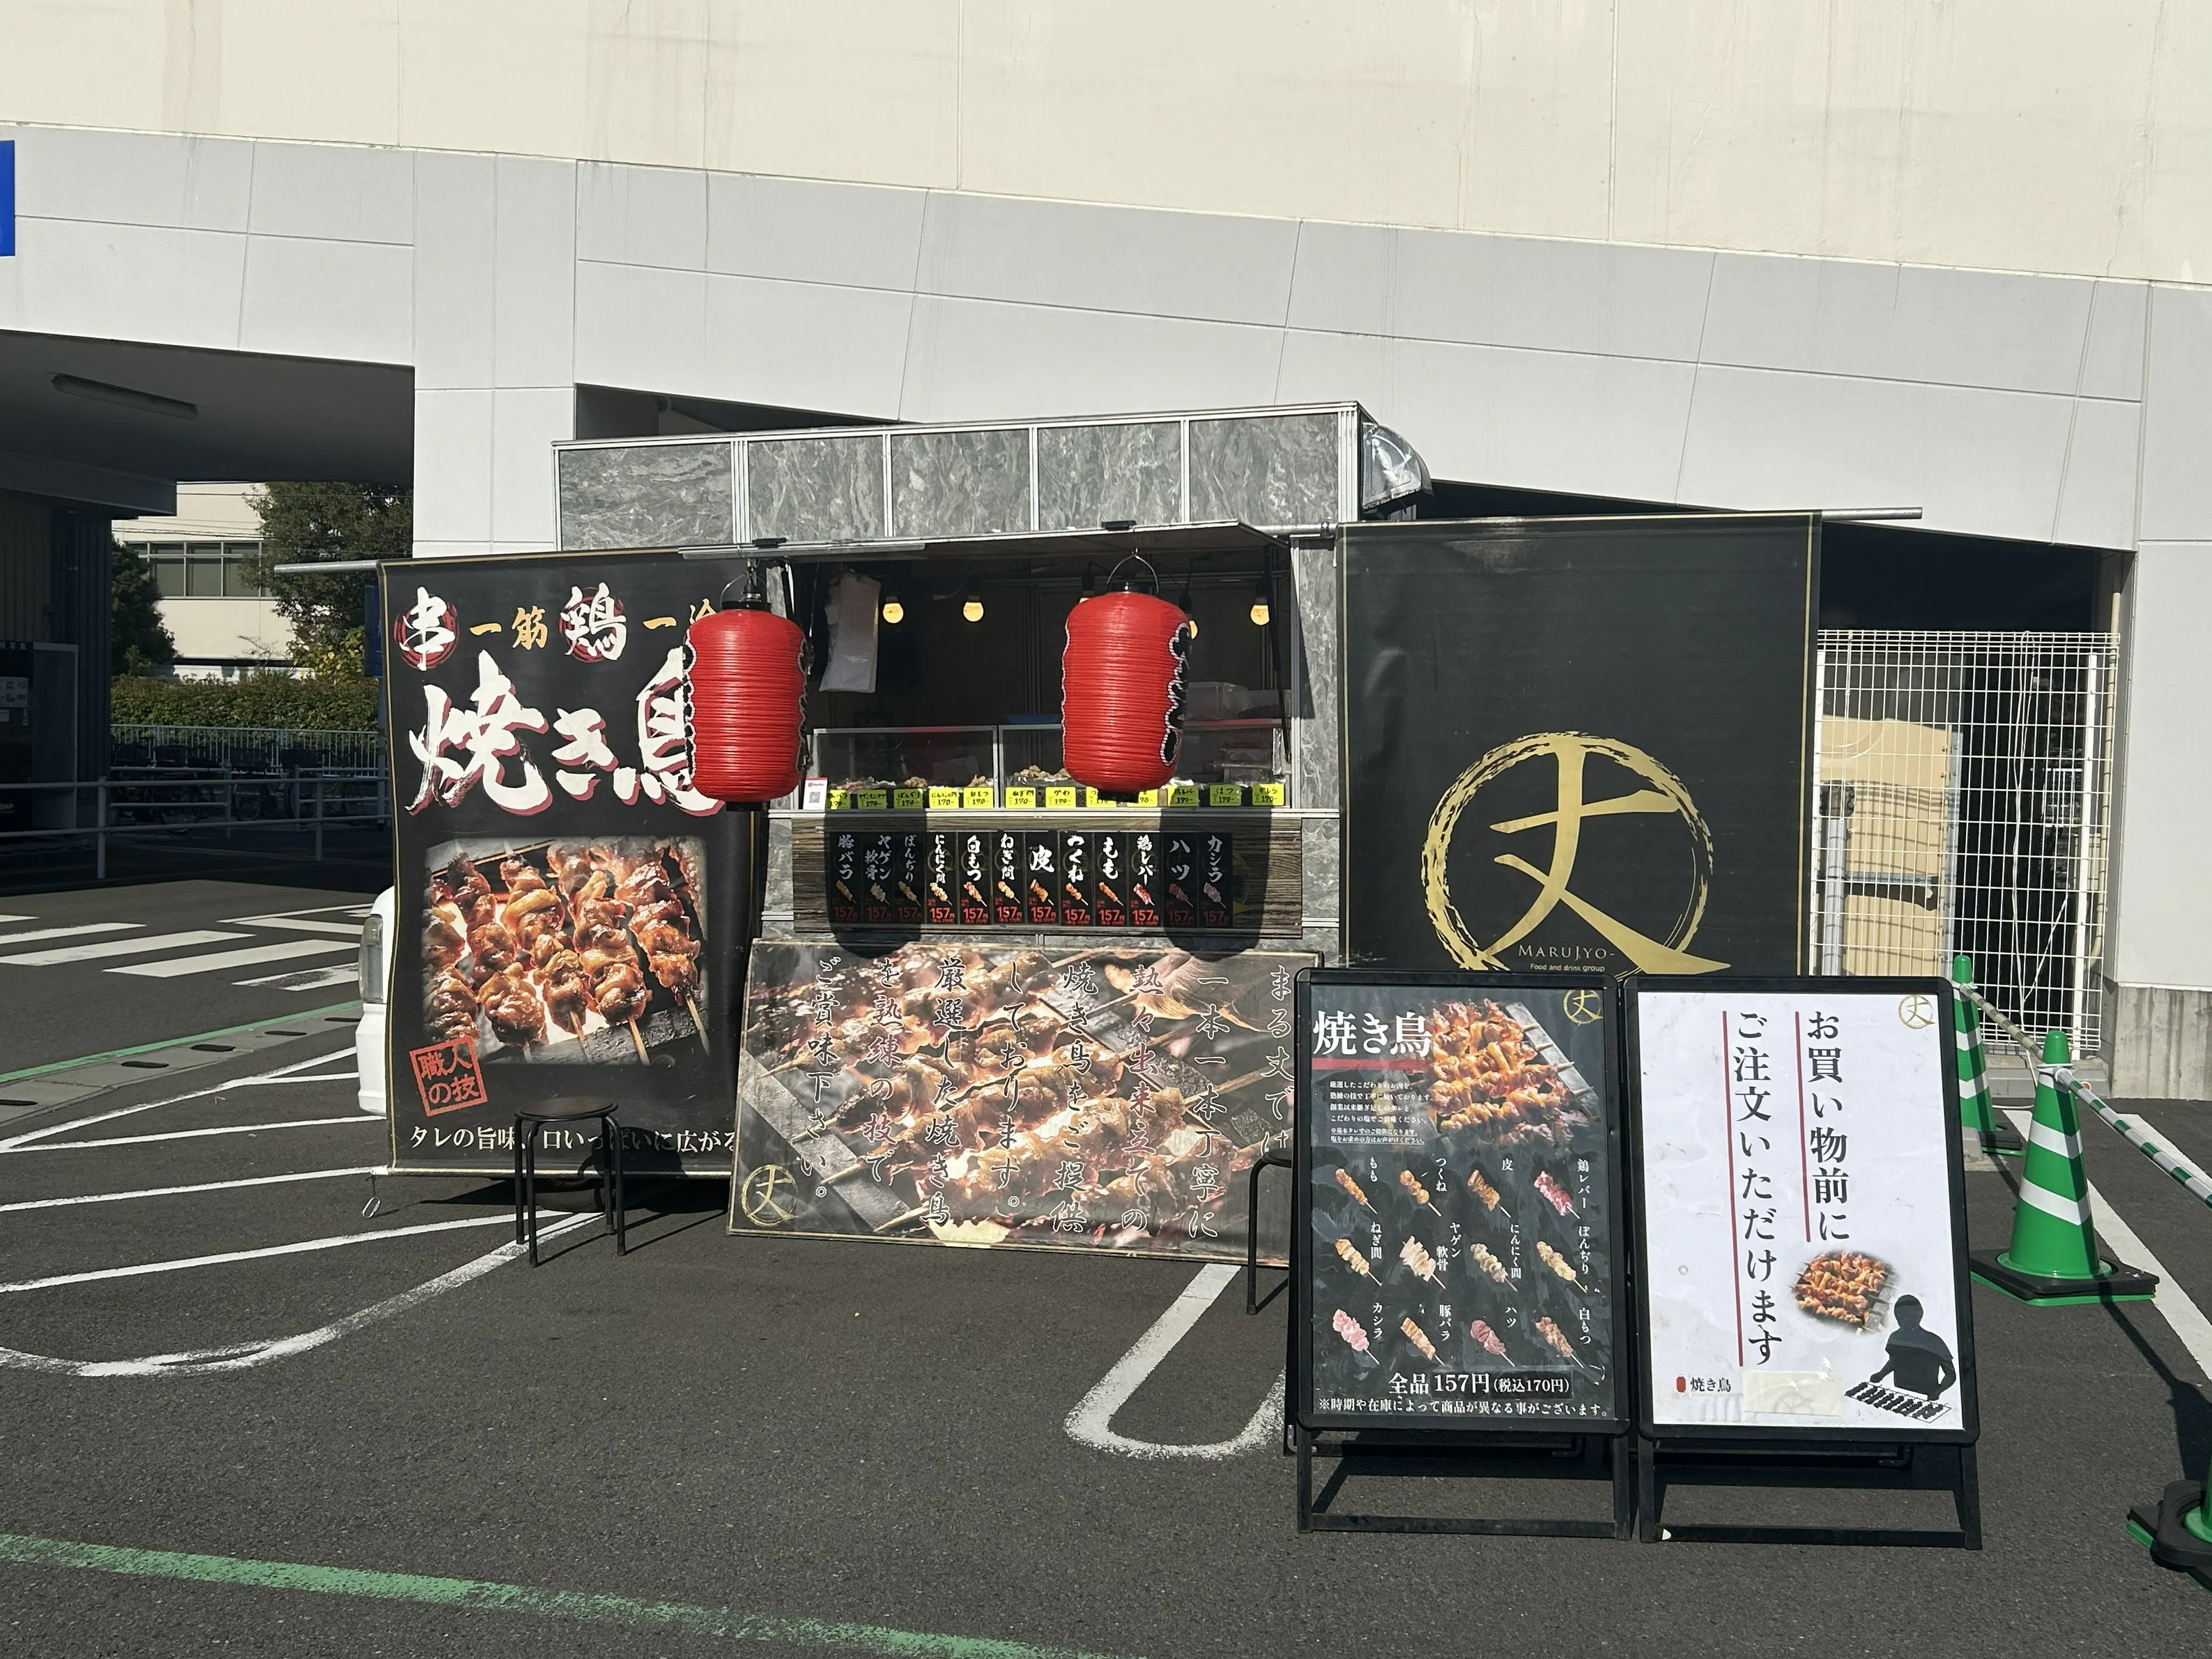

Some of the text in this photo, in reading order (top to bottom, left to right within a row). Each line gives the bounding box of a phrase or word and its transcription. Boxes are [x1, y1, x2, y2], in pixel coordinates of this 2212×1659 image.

[838, 834, 854, 879] 豚バラ
[878, 834, 893, 880] ヤゲン
[935, 834, 946, 884] にんにく間
[967, 835, 982, 881] 白もつ
[1001, 833, 1015, 880] ねぎ間
[1030, 845, 1054, 873] 皮
[1067, 835, 1085, 882] つくね
[1102, 837, 1119, 879] もも
[1137, 835, 1153, 885] 鶏レバー
[1169, 839, 1190, 880] ハツ
[1207, 835, 1223, 883] カシラ
[1313, 1010, 1432, 1057] 焼き鳥
[417, 1045, 473, 1080] 職人
[799, 956, 842, 1198] ご賞味下さい。
[863, 958, 904, 1183] を熟練の技で
[990, 960, 1027, 1206] しております。
[428, 1074, 479, 1103] の技
[919, 957, 967, 1227] 厳選した焼き鳥
[1049, 961, 1099, 1233] 焼き鳥をご提供
[1121, 964, 1165, 1232] 熱々出来立ての
[1188, 976, 1231, 1238] 一本一本丁寧に
[1807, 1011, 1850, 1241] お買い物前に
[1369, 1156, 1378, 1182] もも
[1435, 1157, 1447, 1193] つくね
[1502, 1158, 1514, 1171] 皮
[1577, 1159, 1590, 1209] 鶏レバー
[1733, 1012, 1783, 1367] ご注文いただけます
[1370, 1221, 1383, 1260] ねぎ間
[1436, 1245, 1449, 1272] 軟骨
[1450, 1222, 1462, 1258] ヤゲン
[1510, 1223, 1521, 1279] にんにく間
[1373, 1302, 1383, 1339] カシラ
[1438, 1304, 1452, 1341] 豚バラ
[1505, 1306, 1517, 1328] ハツ
[1578, 1308, 1592, 1344] 白もつ
[1319, 1398, 1608, 1417] ※時期や在庫によって商品が異なる事がございます。
[1690, 1376, 1731, 1393] 焼き鳥
